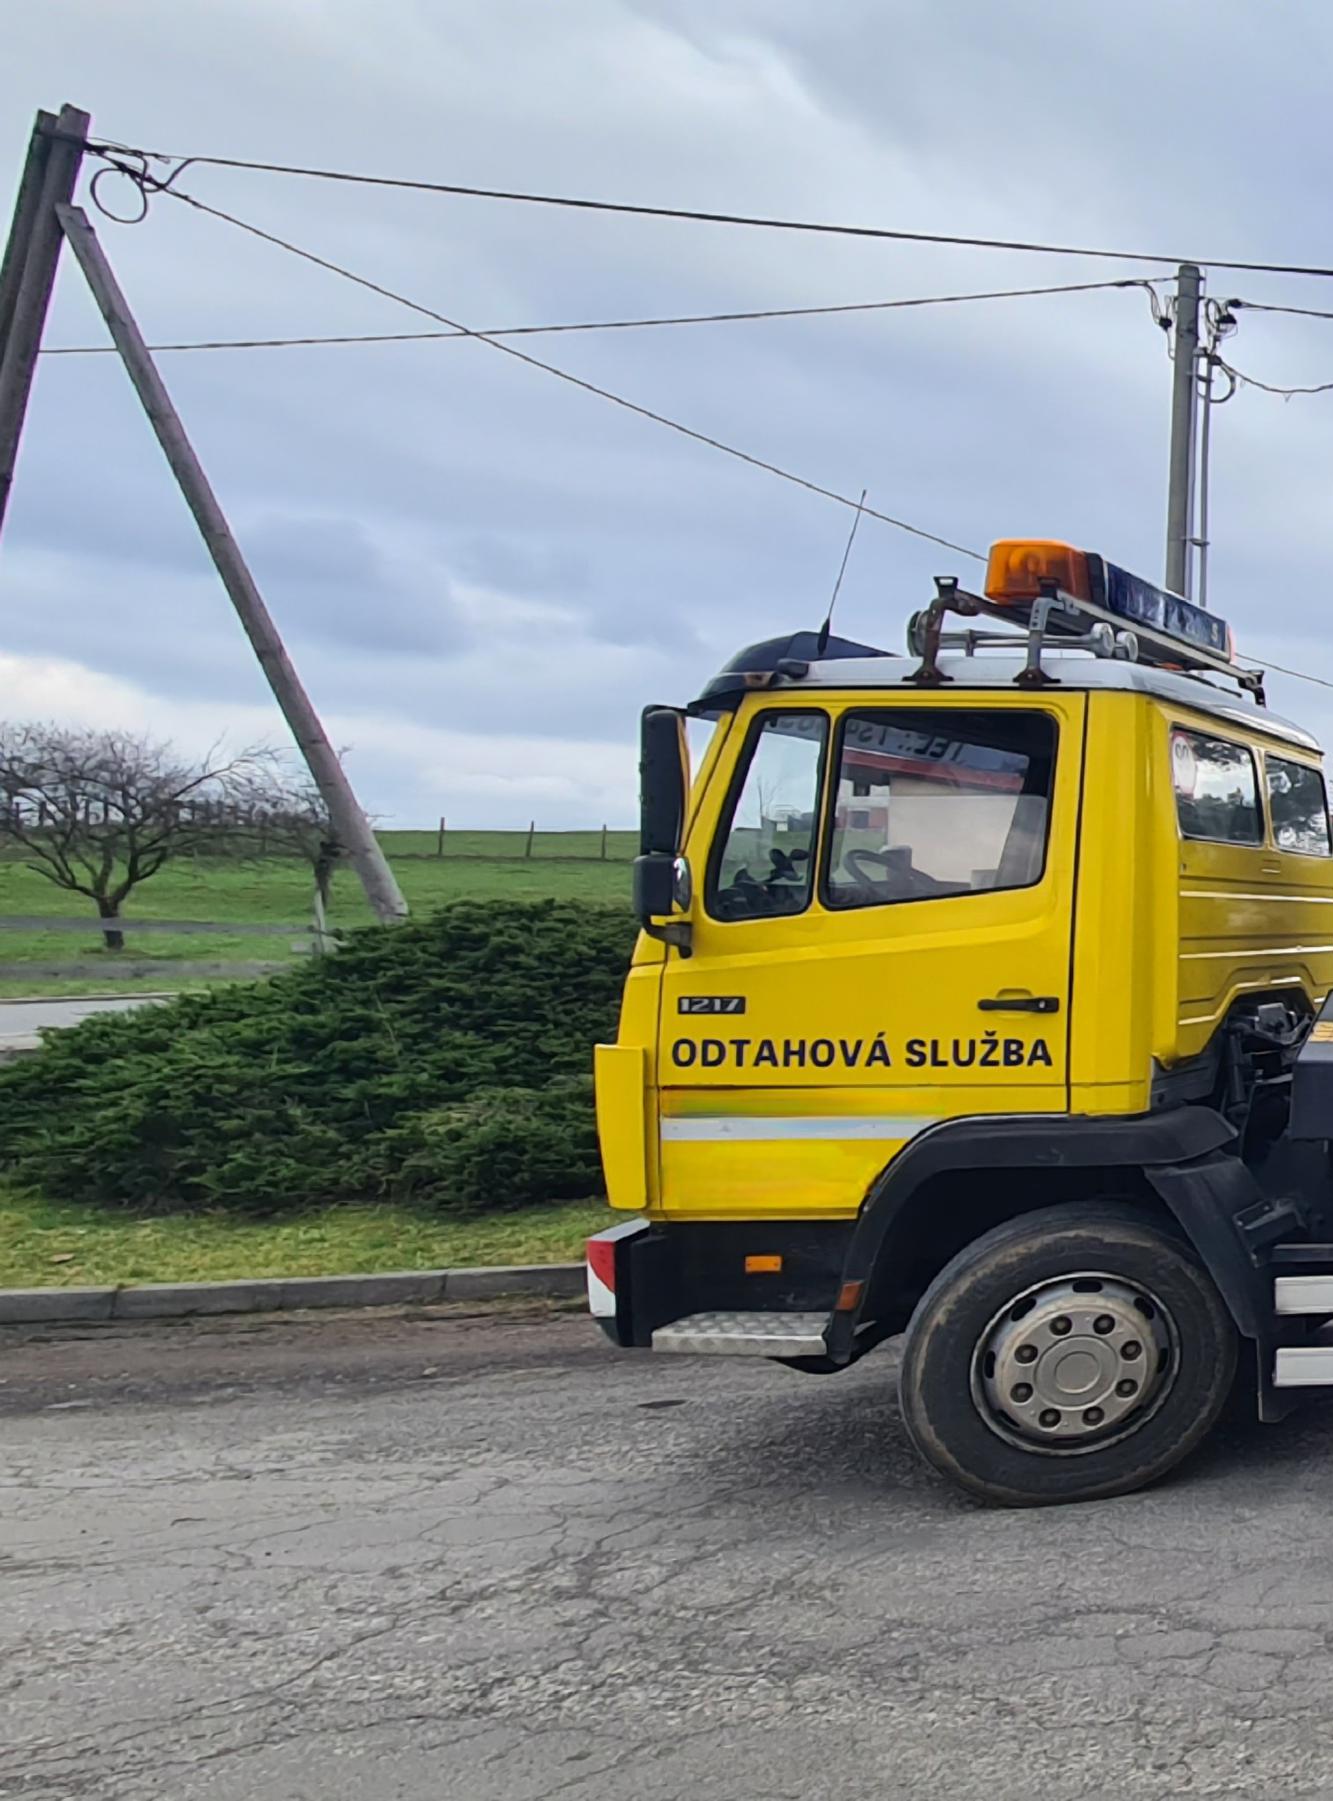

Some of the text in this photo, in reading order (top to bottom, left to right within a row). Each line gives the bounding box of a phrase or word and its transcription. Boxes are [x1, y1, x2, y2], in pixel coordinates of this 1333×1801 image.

[680, 997, 741, 1012] 1217
[671, 1030, 1053, 1068] ODTAHOVÁ SLUŽBA
